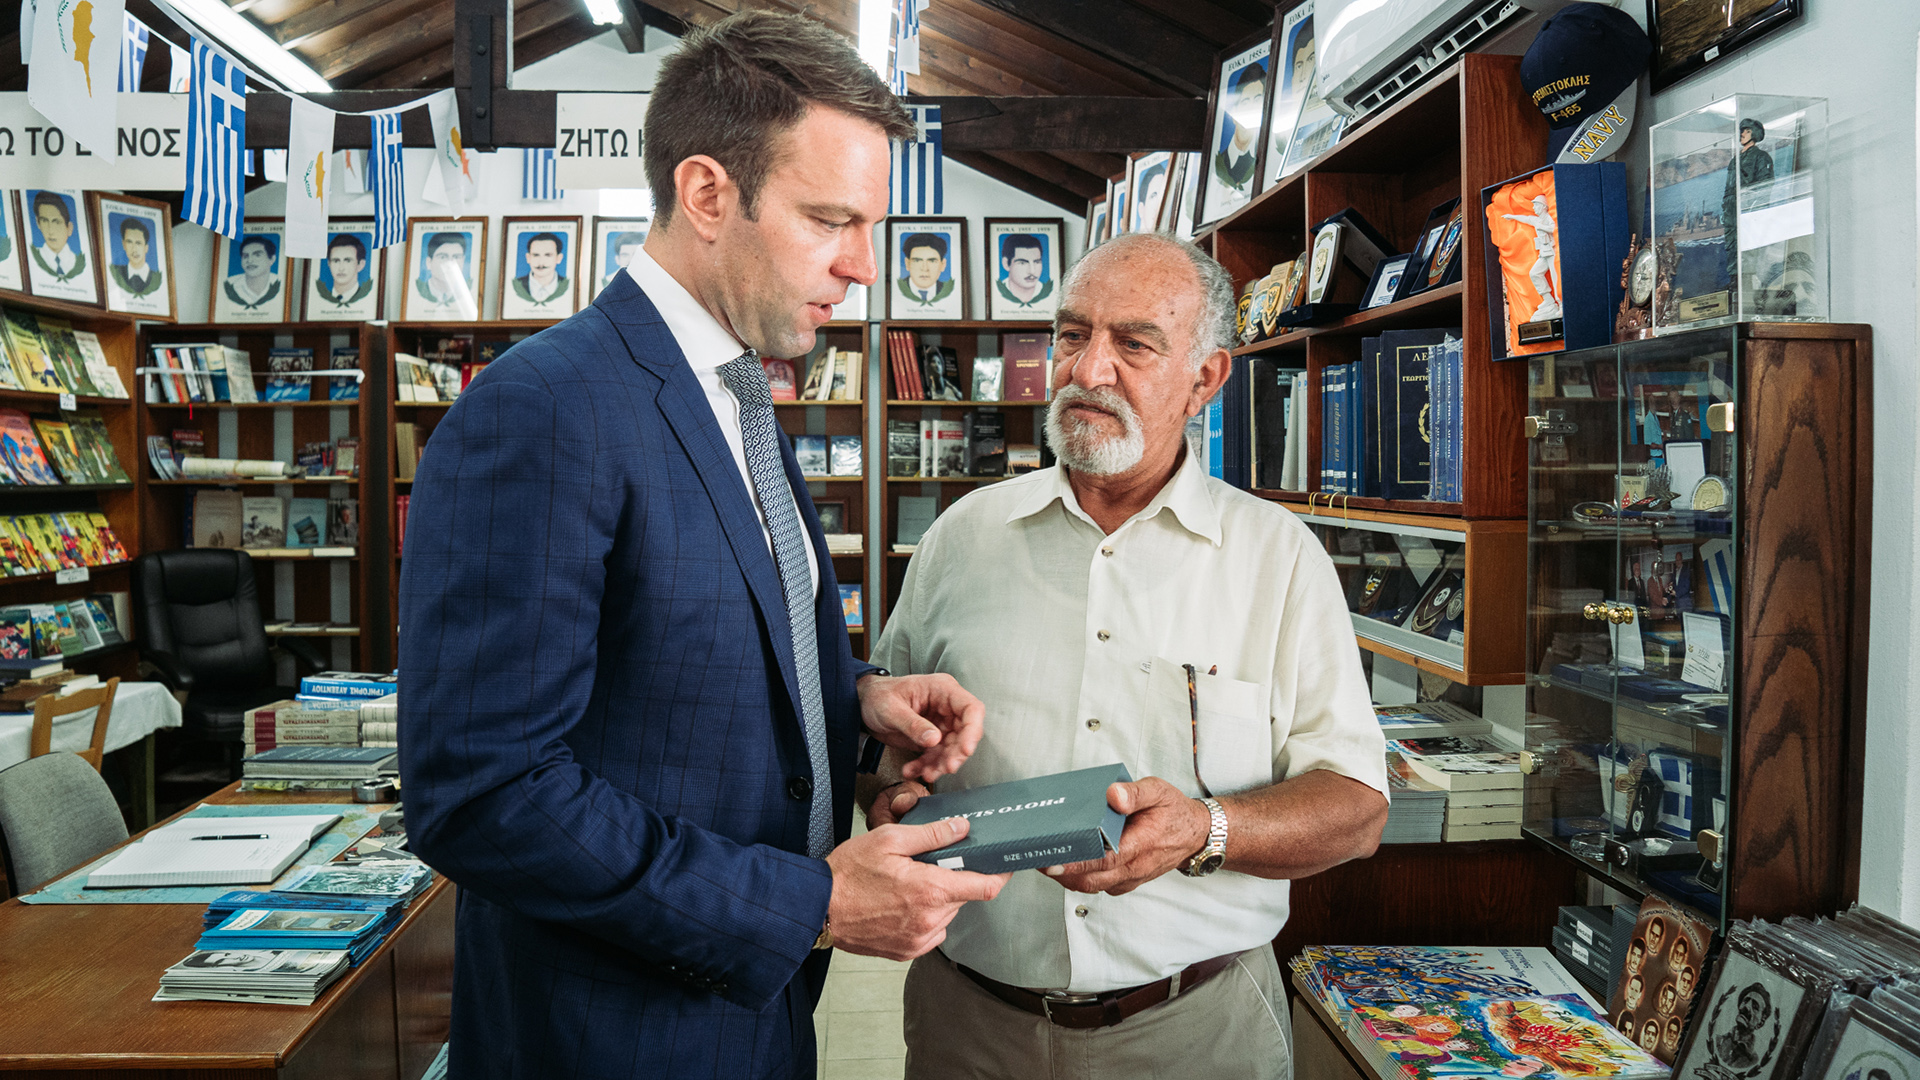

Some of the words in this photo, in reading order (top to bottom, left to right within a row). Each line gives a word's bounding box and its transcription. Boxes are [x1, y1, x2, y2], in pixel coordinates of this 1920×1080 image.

[1551, 103, 1582, 122] F-465
[25, 127, 64, 156] ΤΟ
[76, 127, 181, 157] ΝΟΣ
[1572, 104, 1627, 162] NAVY
[560, 128, 628, 157] ΖΗΤΩ
[311, 684, 348, 696] ΑΥΞΕΝΤΙΟΥ
[349, 686, 384, 697] ΓΡΗΓΟΡΗΣ
[939, 809, 995, 821] SLA
[998, 797, 1066, 815] PHOTO
[1003, 852, 1023, 862] SIZE:
[1024, 845, 1072, 860] 19.7x14.7x2.7
